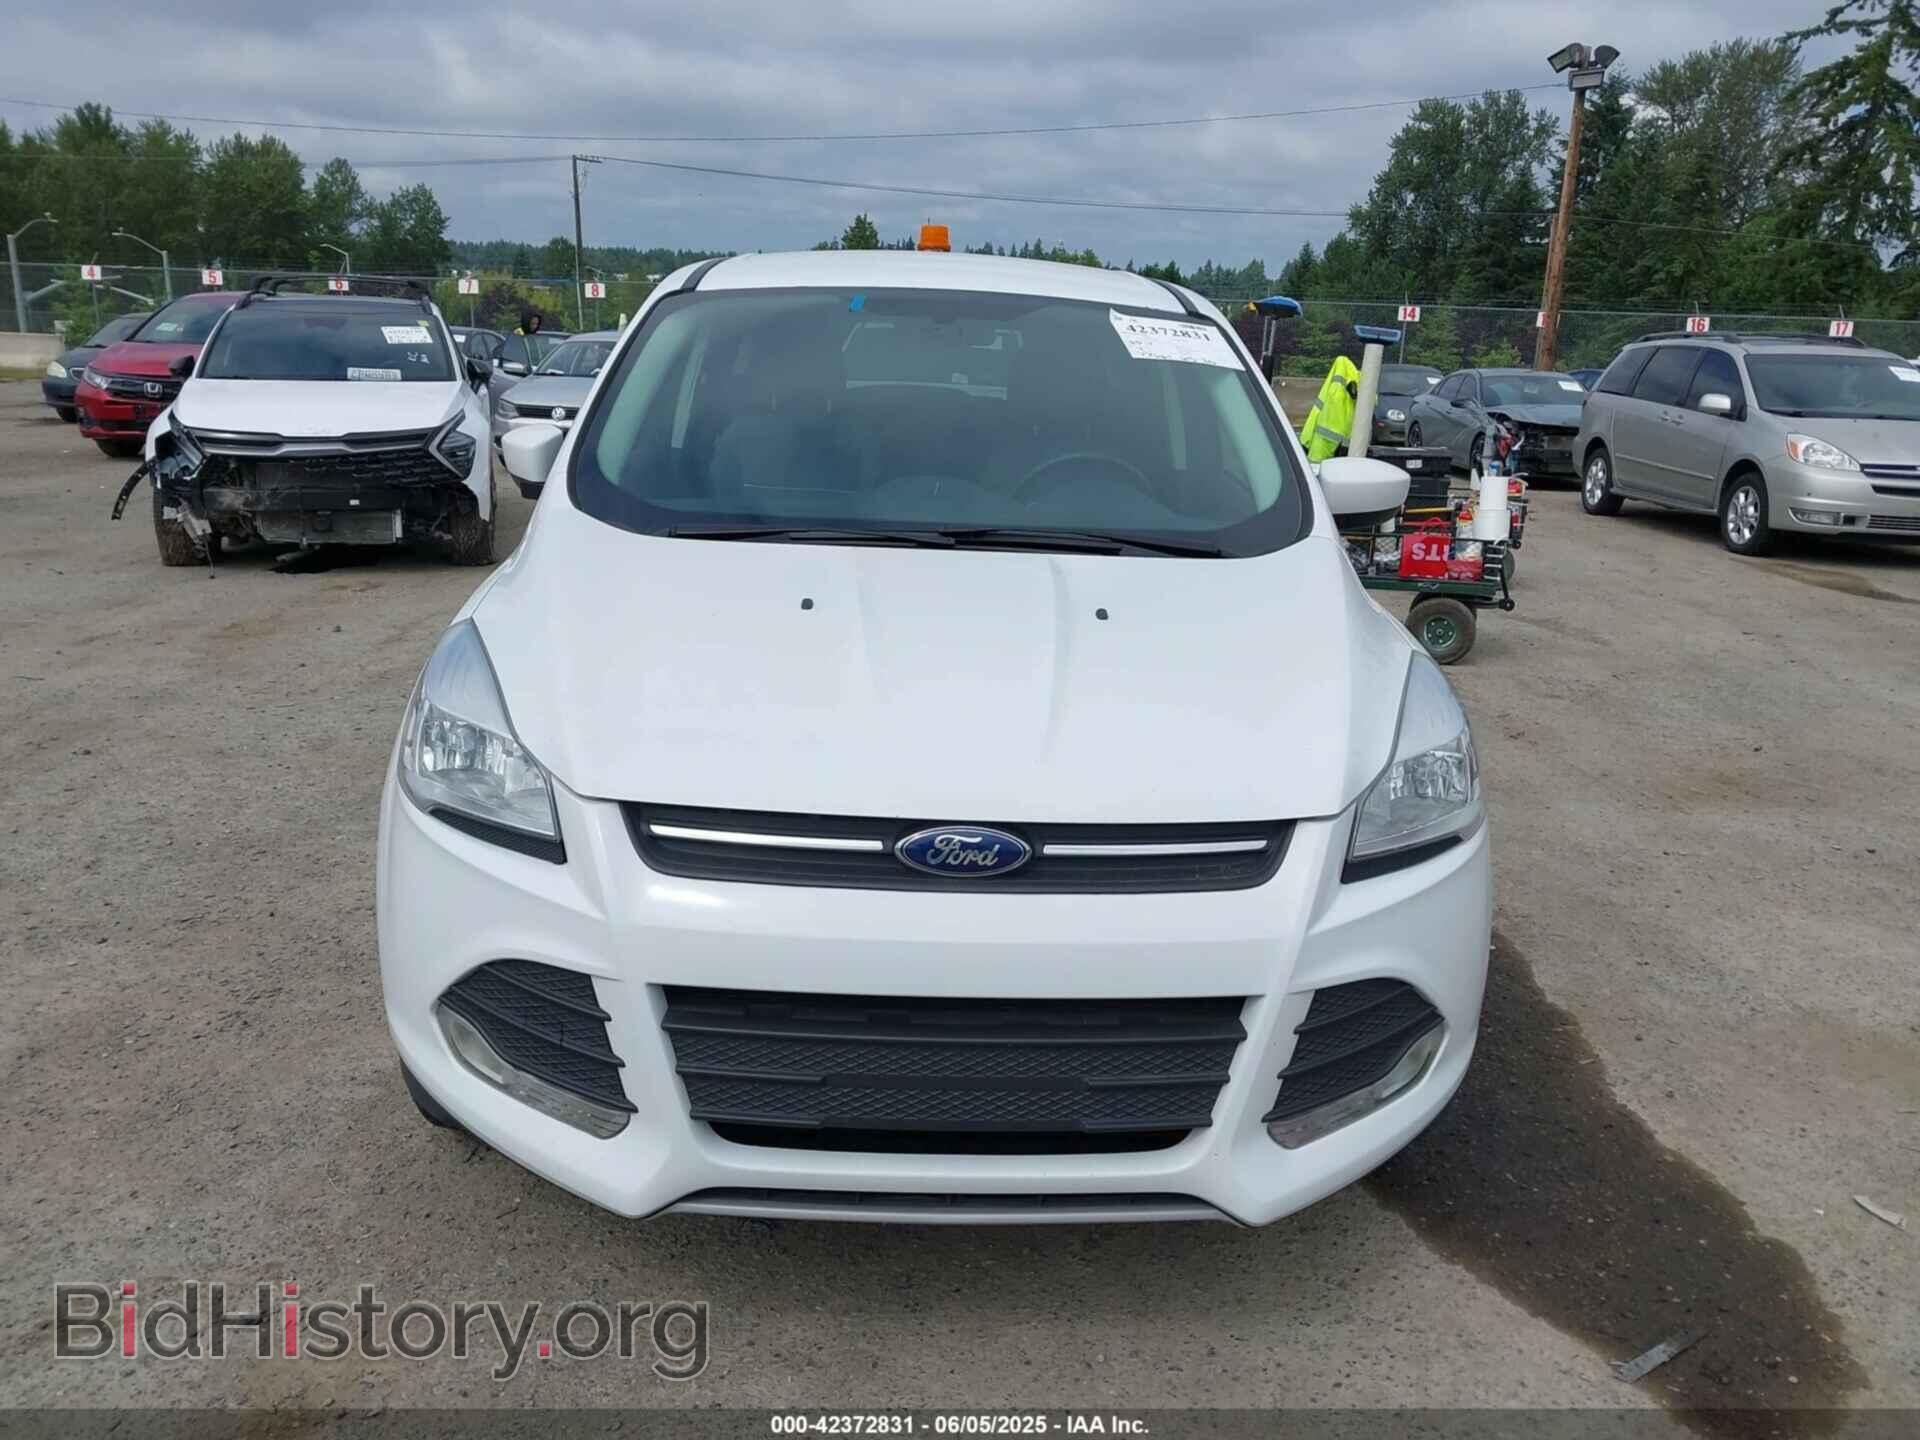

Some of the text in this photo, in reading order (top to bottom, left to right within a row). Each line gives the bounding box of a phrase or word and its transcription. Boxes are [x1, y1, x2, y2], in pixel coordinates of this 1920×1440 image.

[86, 265, 96, 278] 4
[208, 271, 217, 284] 5
[464, 280, 472, 293] 7
[591, 284, 599, 297] 8
[1402, 307, 1417, 320] 14
[1690, 319, 1706, 331] 16
[1835, 322, 1849, 335] 17
[926, 834, 1001, 866] Ford
